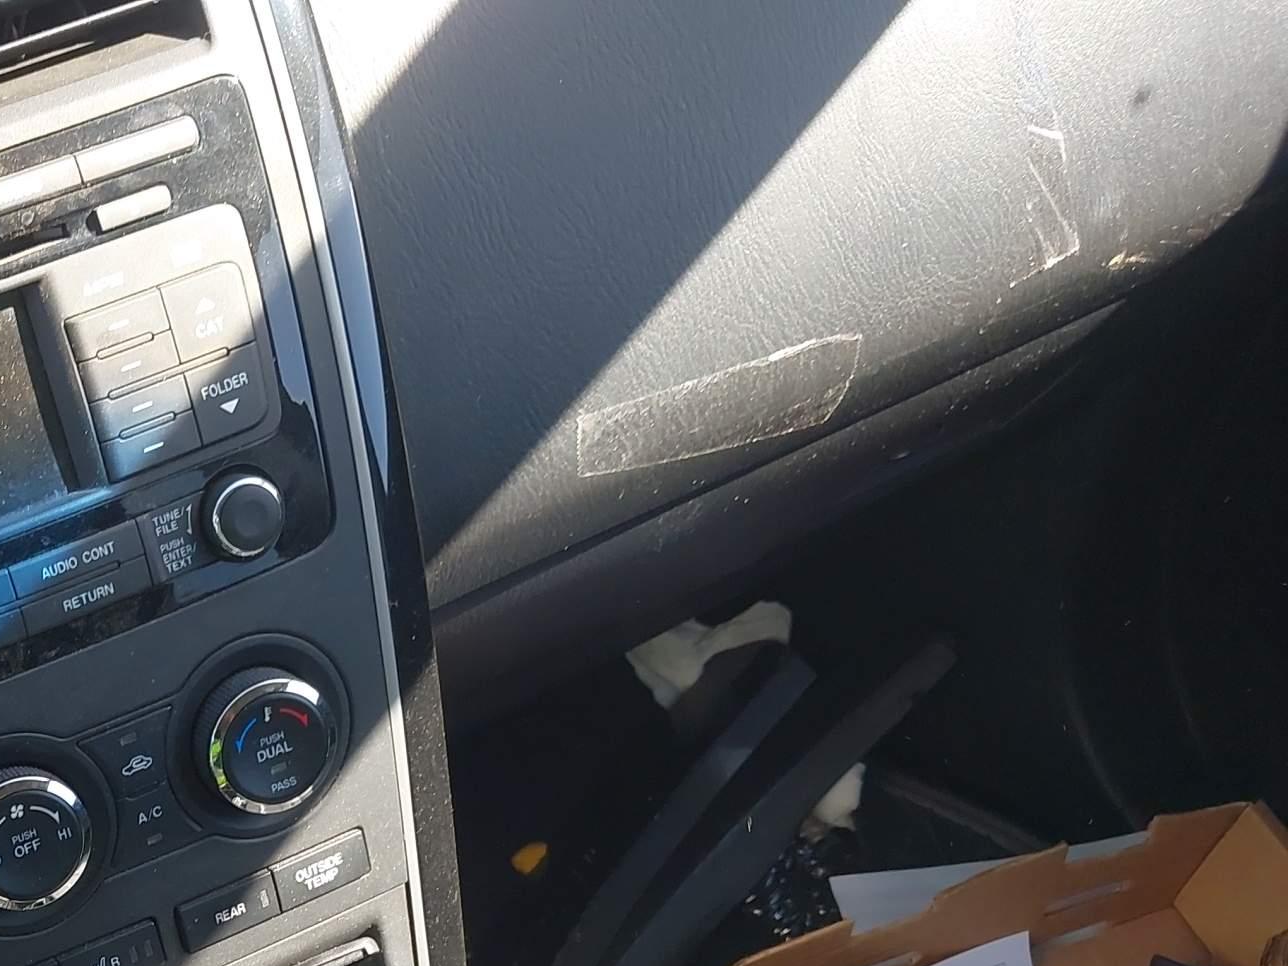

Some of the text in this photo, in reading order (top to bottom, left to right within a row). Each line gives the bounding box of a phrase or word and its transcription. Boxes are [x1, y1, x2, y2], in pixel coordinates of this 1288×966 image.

[201, 372, 248, 400] FOLDER
[155, 521, 179, 537] FILE
[160, 537, 184, 553] PUSH
[42, 542, 115, 580] AUDIO CONT
[166, 557, 193, 574] TEXT
[63, 583, 114, 612] RETURN
[259, 731, 285, 747] PUSH
[256, 743, 294, 763] DUAL
[270, 776, 297, 794] PASS
[138, 806, 163, 824] A/C
[11, 828, 38, 846] PUSH
[57, 827, 73, 841] HI
[14, 838, 41, 859] OFF
[295, 852, 344, 883] OUTSIDE
[304, 868, 340, 891] TEMP
[215, 902, 247, 925] REAR
